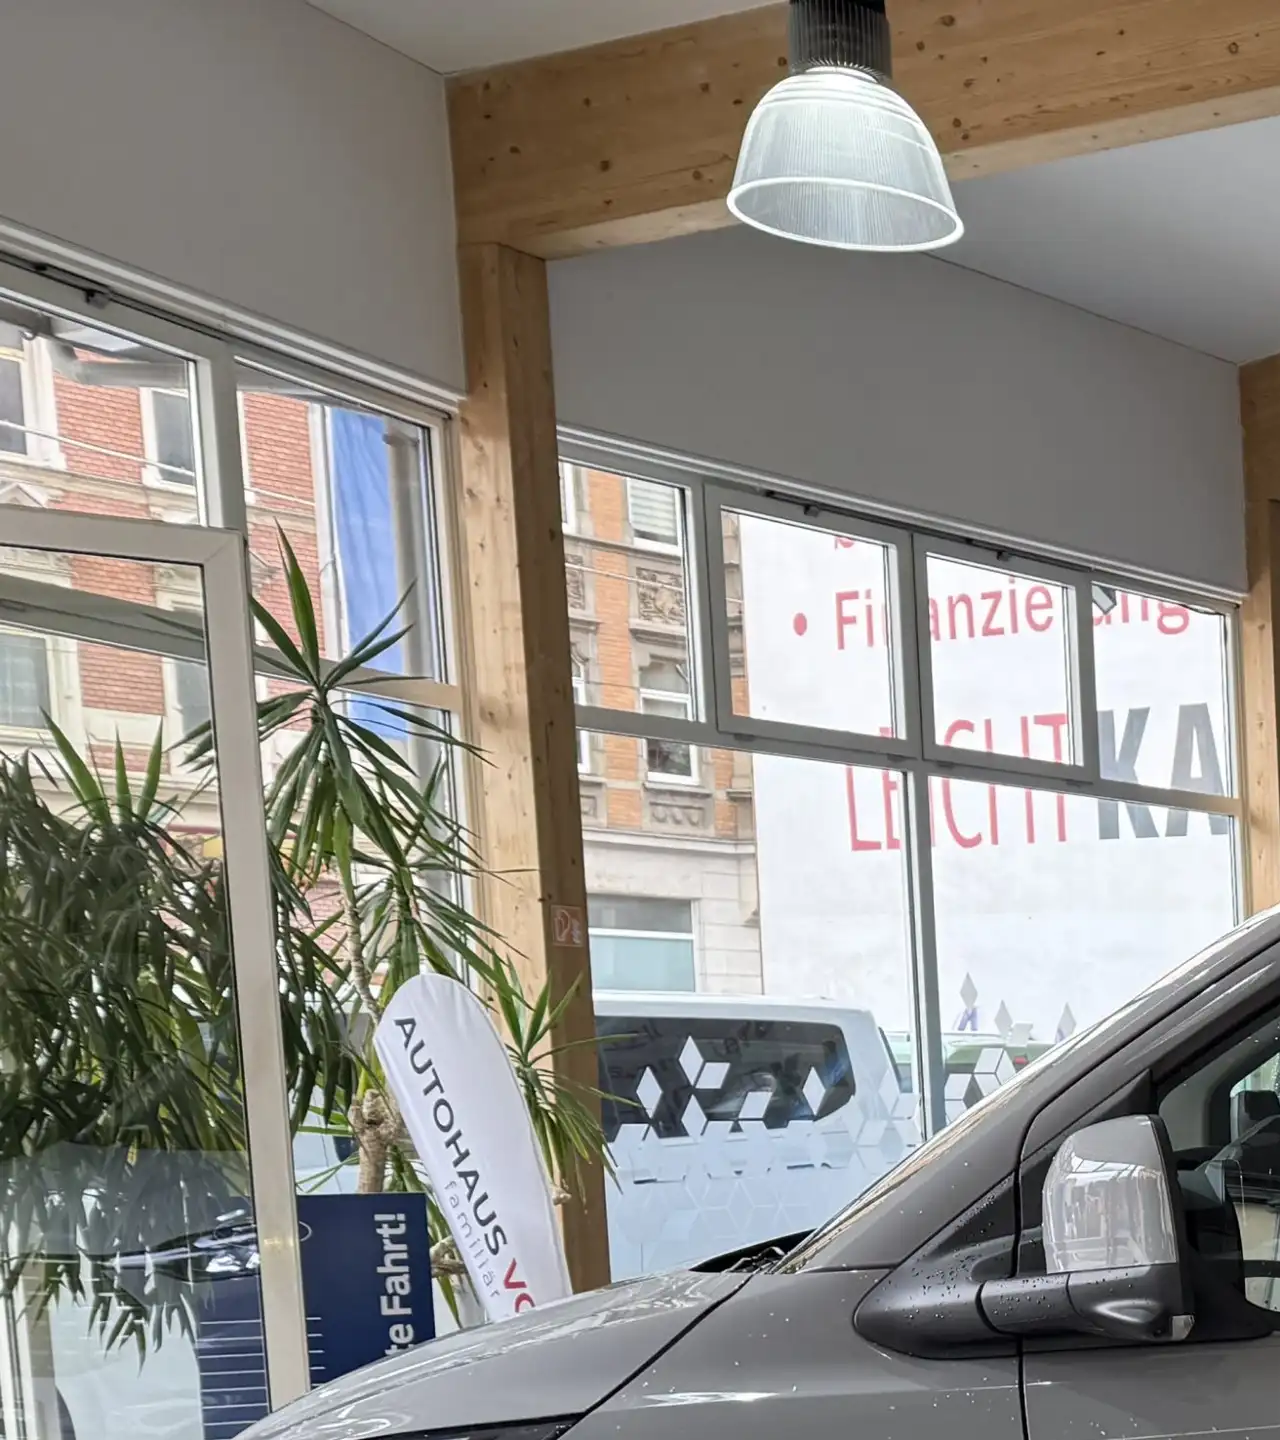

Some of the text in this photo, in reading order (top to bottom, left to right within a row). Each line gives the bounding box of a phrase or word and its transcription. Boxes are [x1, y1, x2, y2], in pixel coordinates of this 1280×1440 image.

[835, 575, 1190, 651] Fianzieng
[393, 1017, 508, 1257] AUTOHAUS
[374, 1213, 413, 1316] Fahrt!
[444, 1180, 500, 1298] familiär
